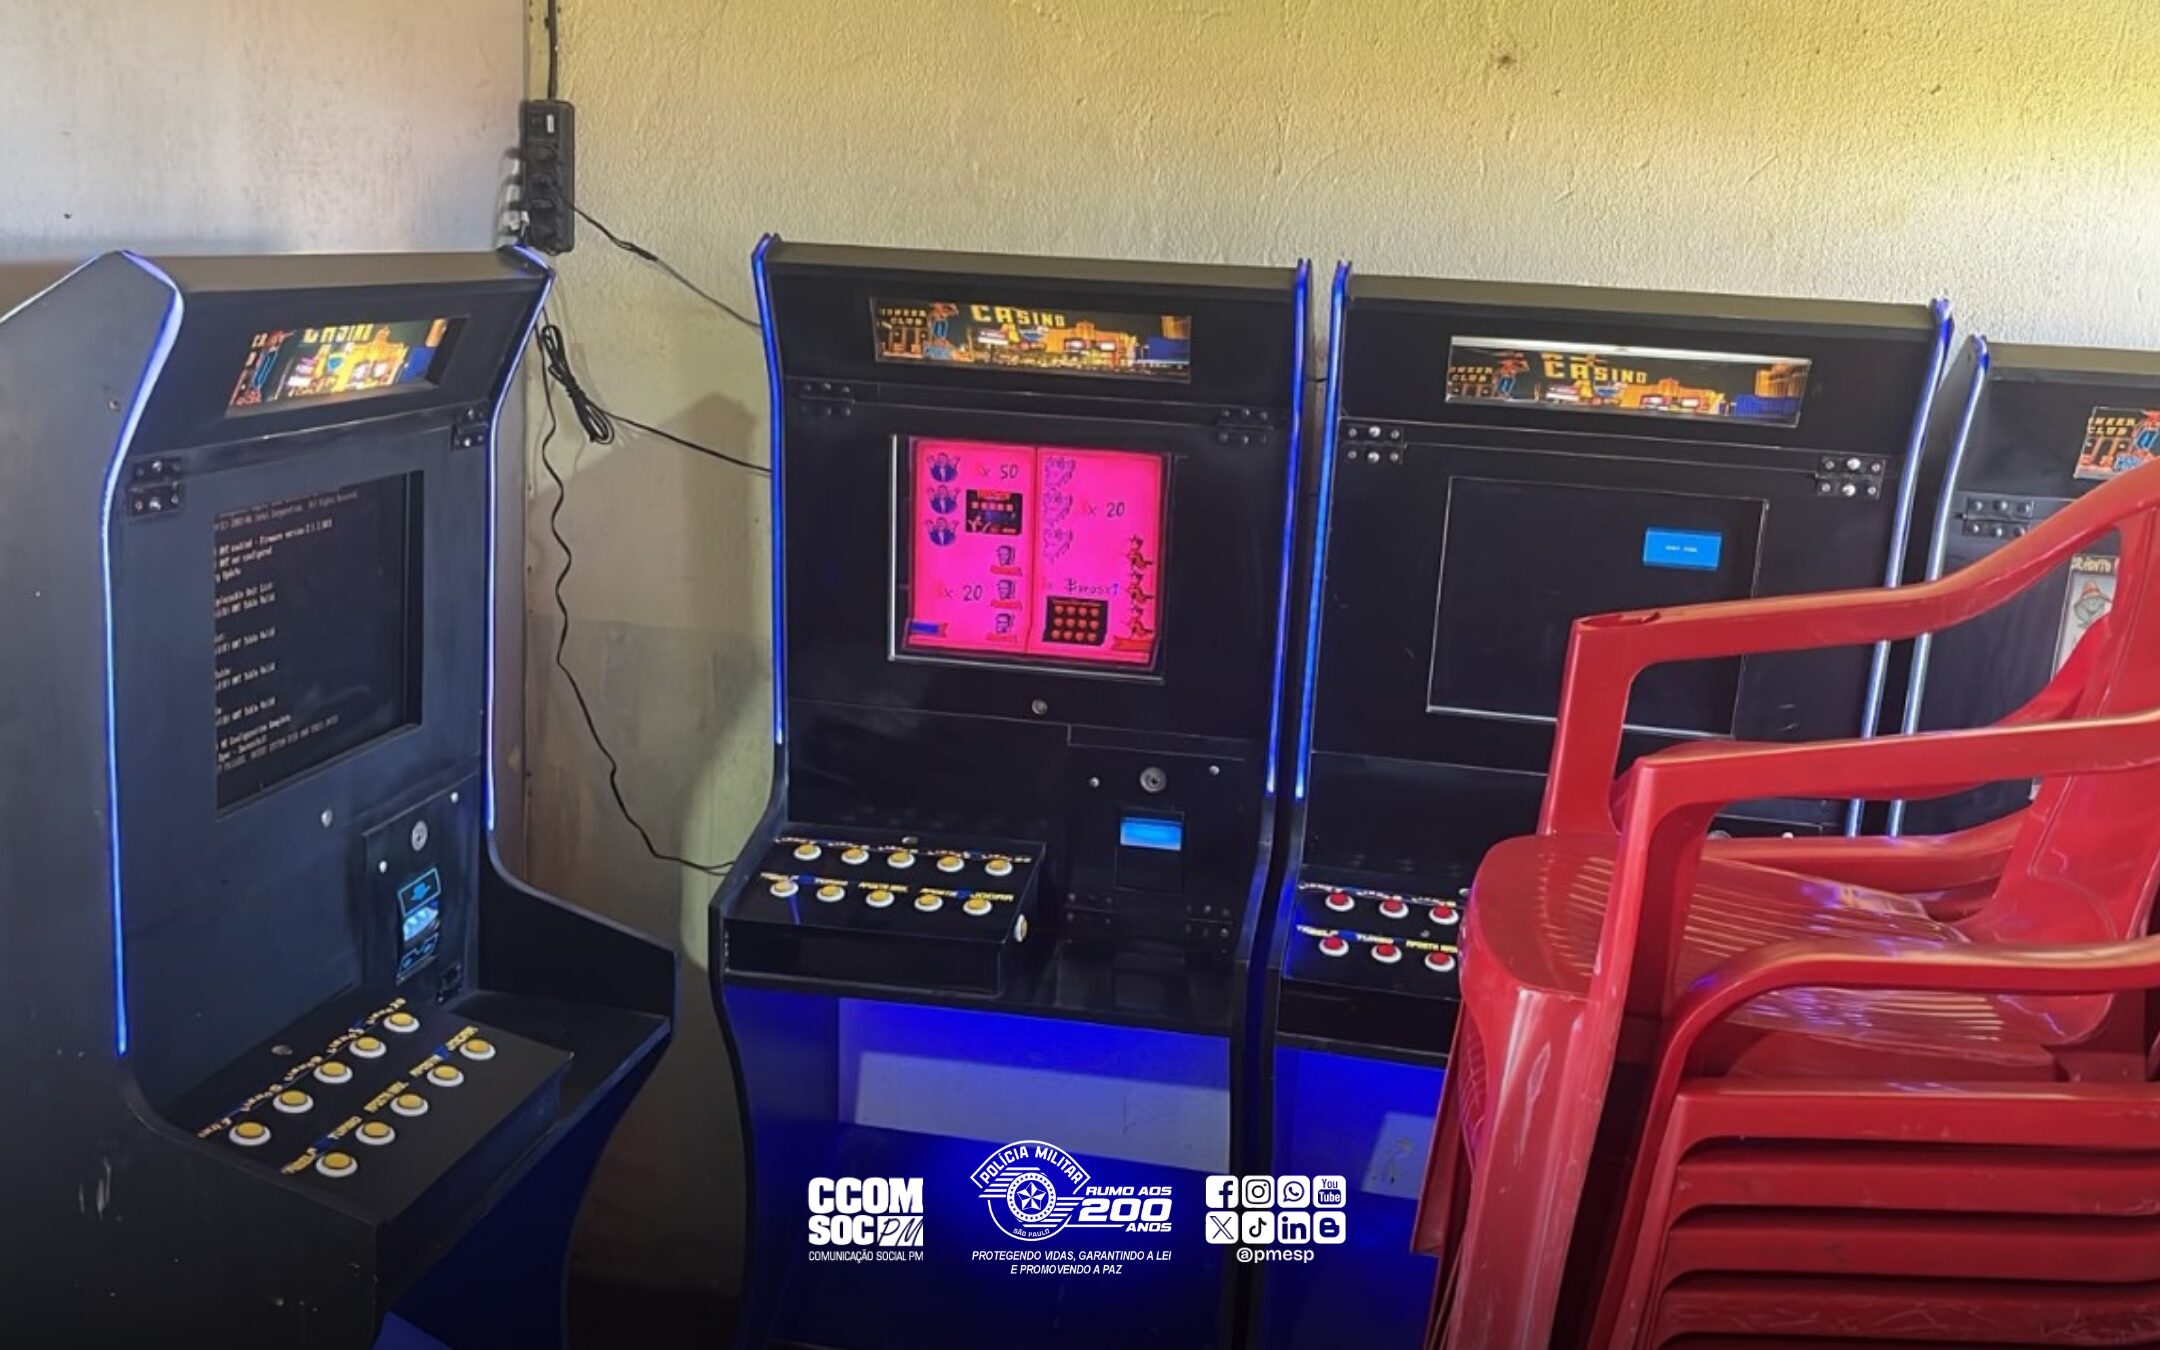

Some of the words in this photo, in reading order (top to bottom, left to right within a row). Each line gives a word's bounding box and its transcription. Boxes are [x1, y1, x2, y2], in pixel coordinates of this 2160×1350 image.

[971, 305, 1066, 327] CASINO
[1543, 360, 1647, 384] CASINO
[1000, 463, 1019, 480] 50
[1106, 501, 1126, 518] 20
[963, 584, 984, 602] 20
